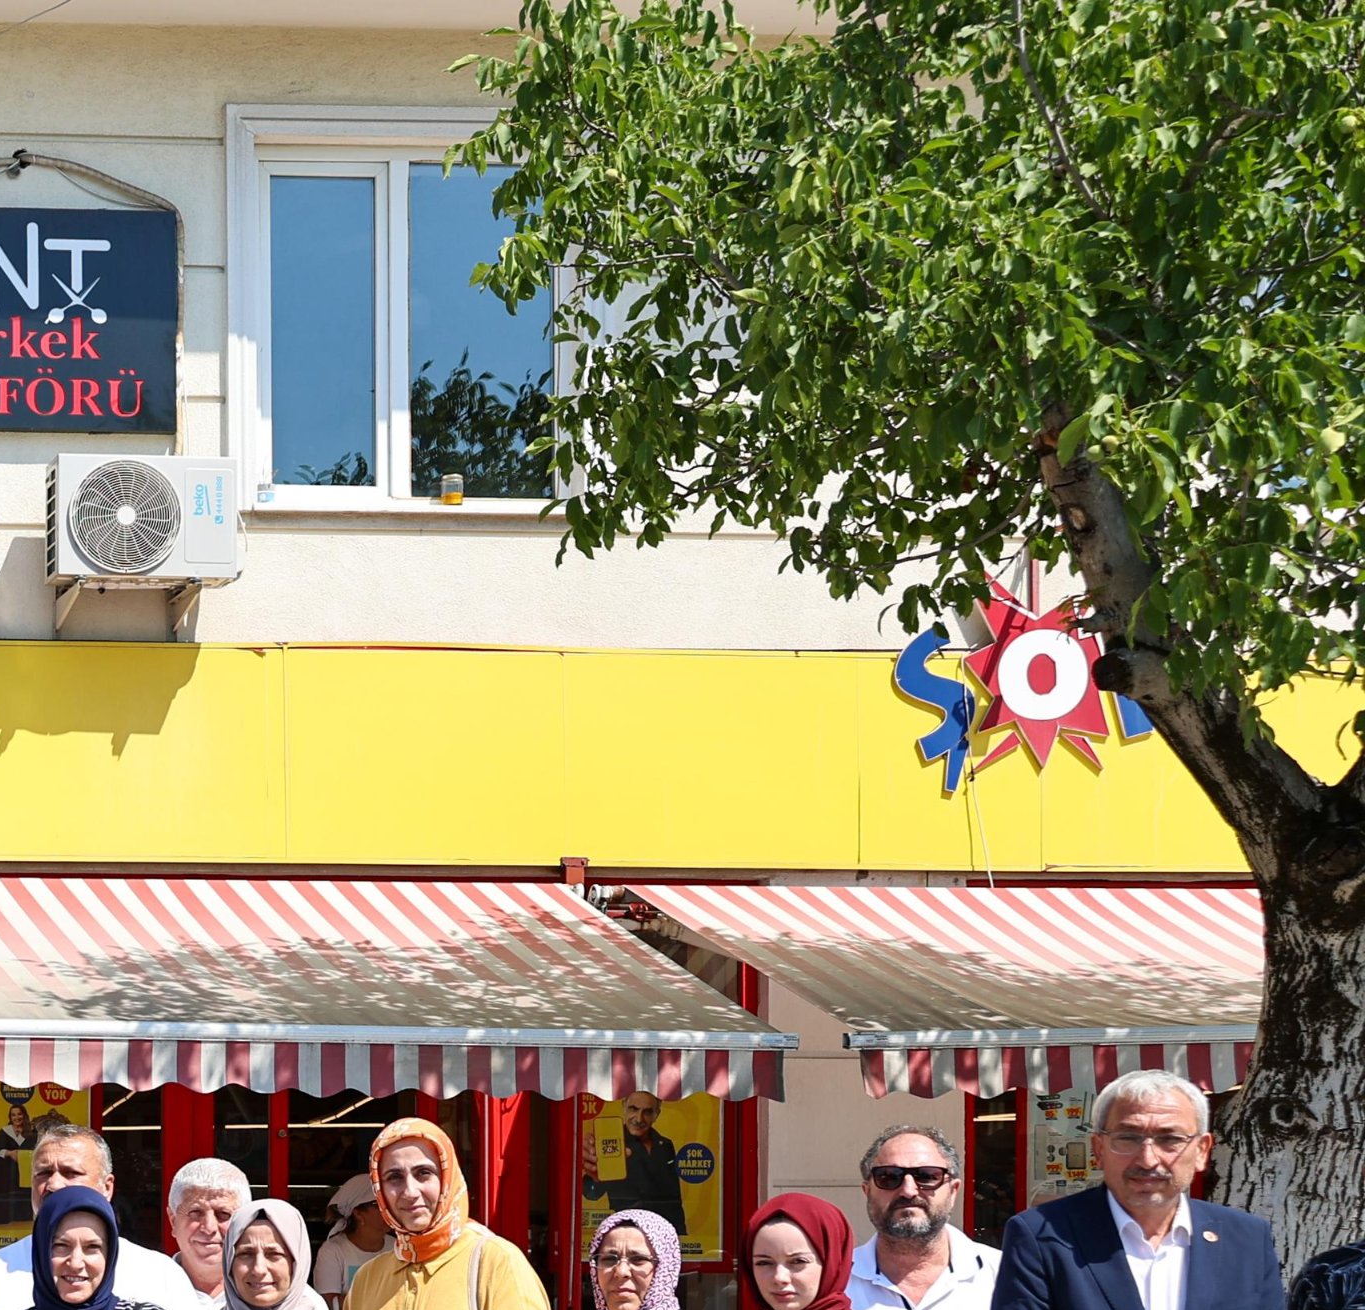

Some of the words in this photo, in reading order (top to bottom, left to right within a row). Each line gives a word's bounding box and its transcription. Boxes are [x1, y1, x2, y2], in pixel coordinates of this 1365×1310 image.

[193, 484, 204, 516] beko
[44, 1089, 67, 1100] YOK
[686, 1149, 704, 1160] ŞOK
[678, 1160, 712, 1168] MARKET
